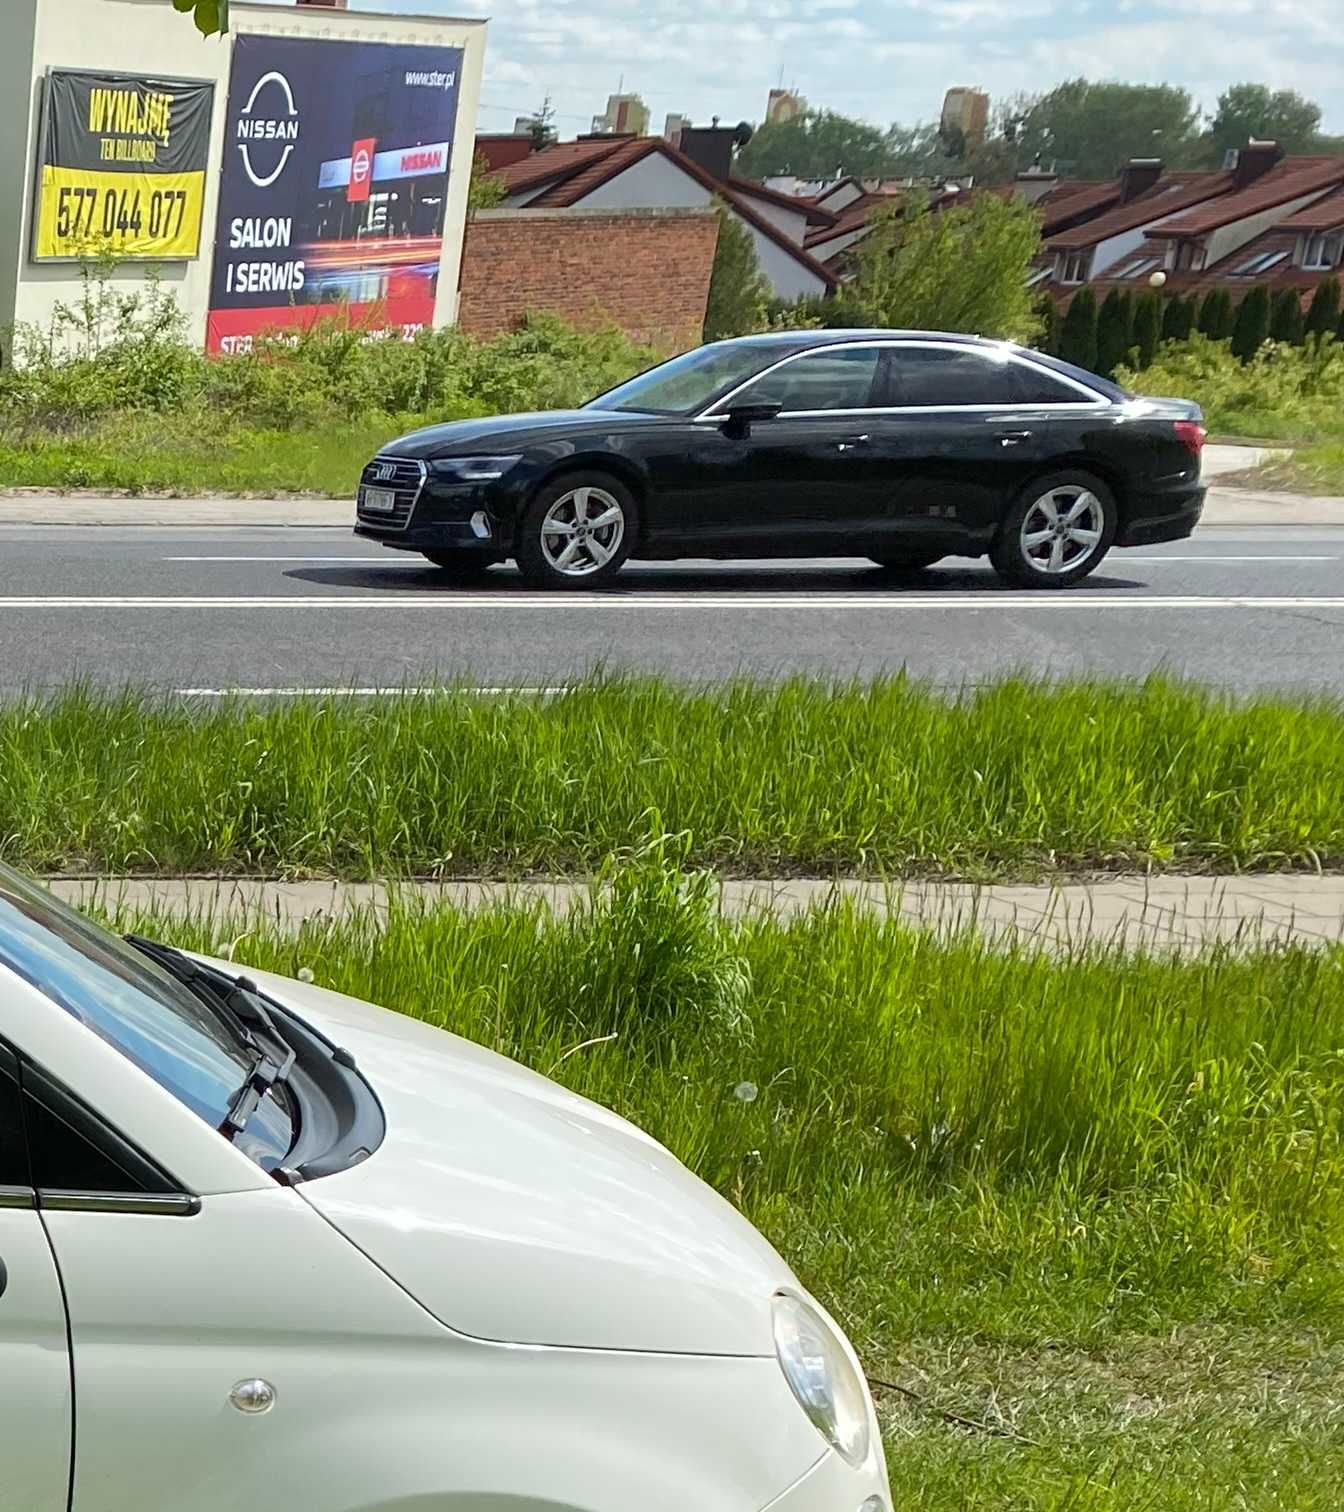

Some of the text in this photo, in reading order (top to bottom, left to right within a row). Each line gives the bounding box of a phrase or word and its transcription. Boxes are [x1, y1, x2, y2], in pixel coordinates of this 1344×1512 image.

[405, 69, 456, 91] www.ster.pl
[89, 87, 175, 148] WYNAJMĘ
[237, 118, 299, 139] NISSAN
[100, 138, 156, 162] TEN BILLBOARD
[399, 150, 442, 173] NISSAN
[57, 187, 187, 238] 577 044 077
[229, 217, 292, 248] SALON
[225, 260, 305, 293] I SERWIS
